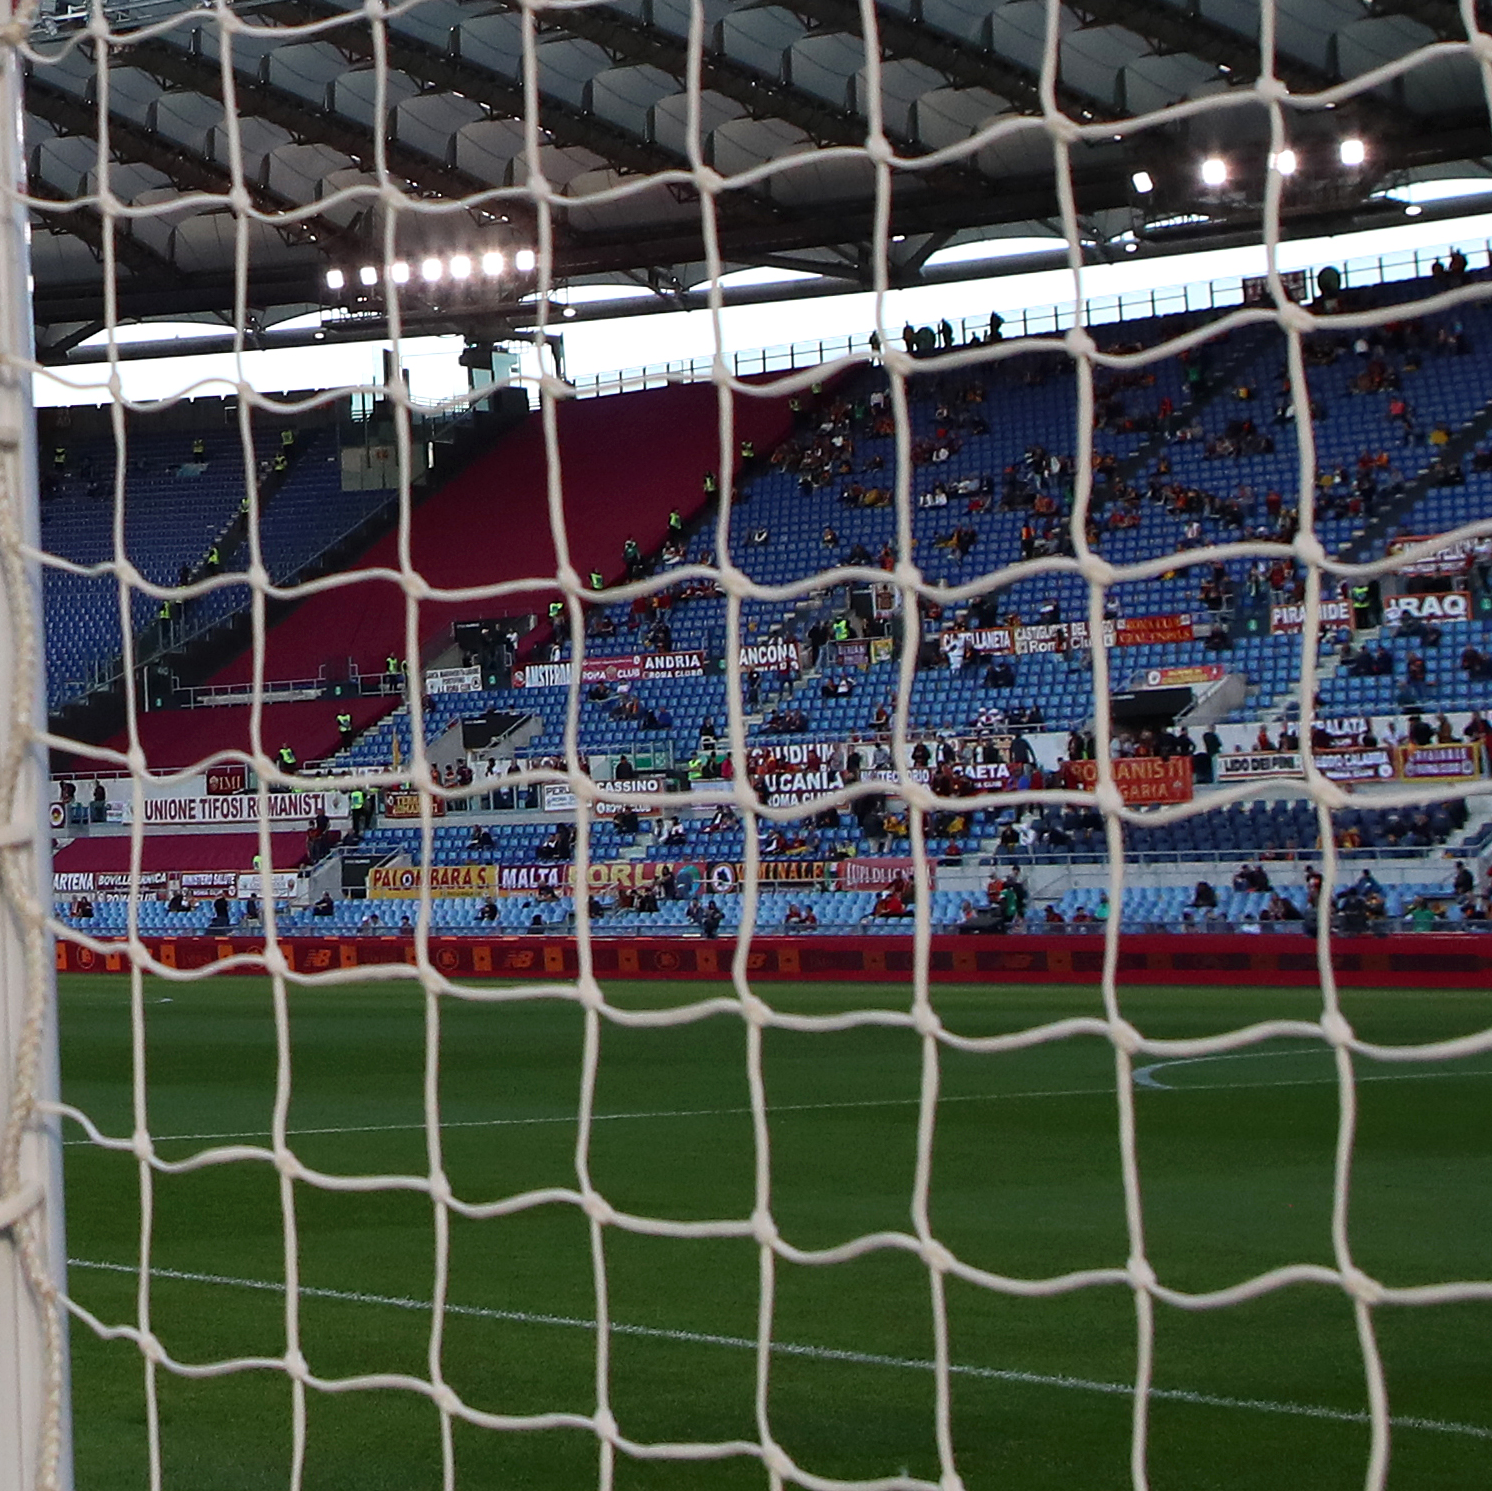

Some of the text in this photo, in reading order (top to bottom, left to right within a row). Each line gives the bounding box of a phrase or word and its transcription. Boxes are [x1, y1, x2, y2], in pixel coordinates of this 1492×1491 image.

[1273, 603, 1350, 625] PIRAIDE
[1070, 637, 1093, 650] Clu
[645, 655, 701, 670] ANDRIA
[739, 643, 799, 666] ANCONA
[1070, 759, 1184, 781] ROANISTI
[597, 780, 659, 793] CASSINO
[763, 772, 844, 793] UCANIA
[144, 798, 196, 820] UNIONE
[199, 796, 243, 819] TIFOSI
[502, 868, 559, 889] MALTA
[736, 862, 825, 879] VMINALE
